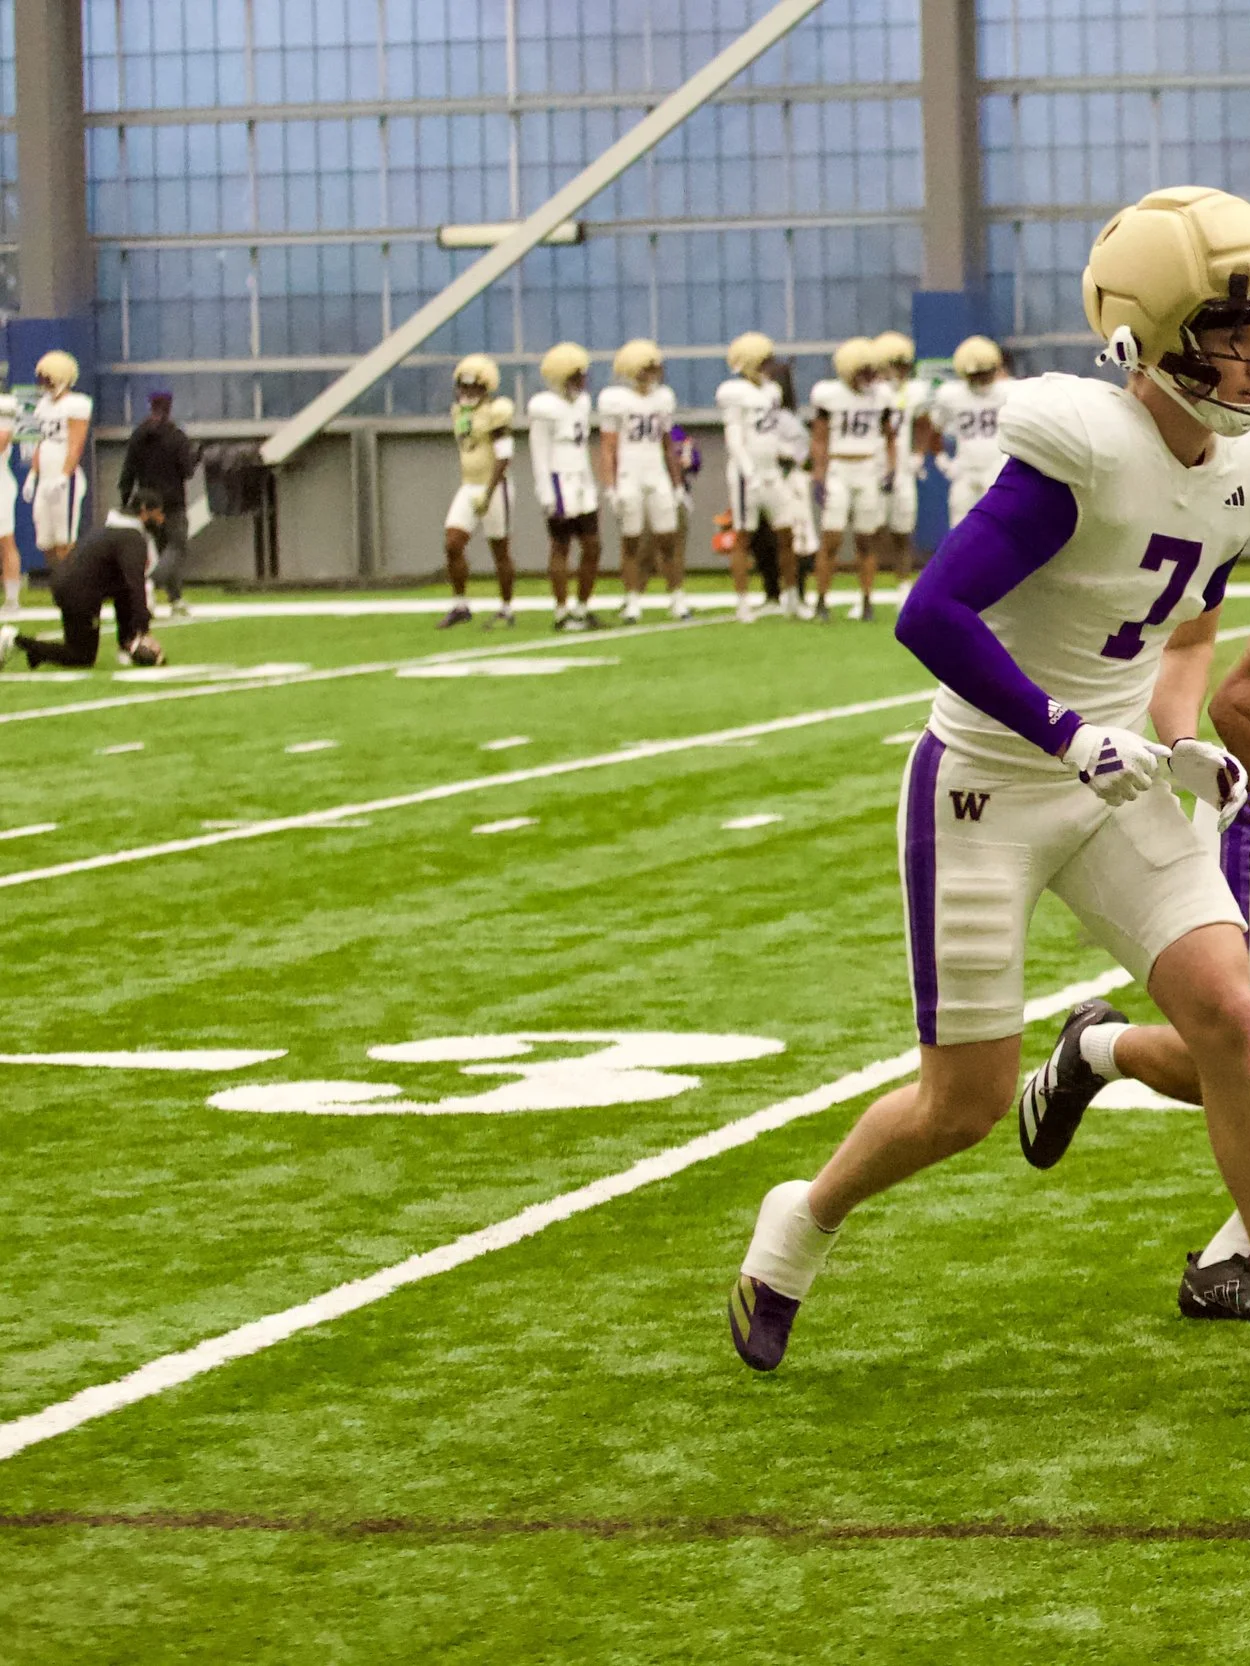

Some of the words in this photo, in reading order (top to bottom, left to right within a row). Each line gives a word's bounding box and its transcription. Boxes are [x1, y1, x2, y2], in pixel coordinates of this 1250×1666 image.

[957, 409, 998, 440] 28
[1101, 533, 1202, 660] 7
[948, 790, 991, 822] W
